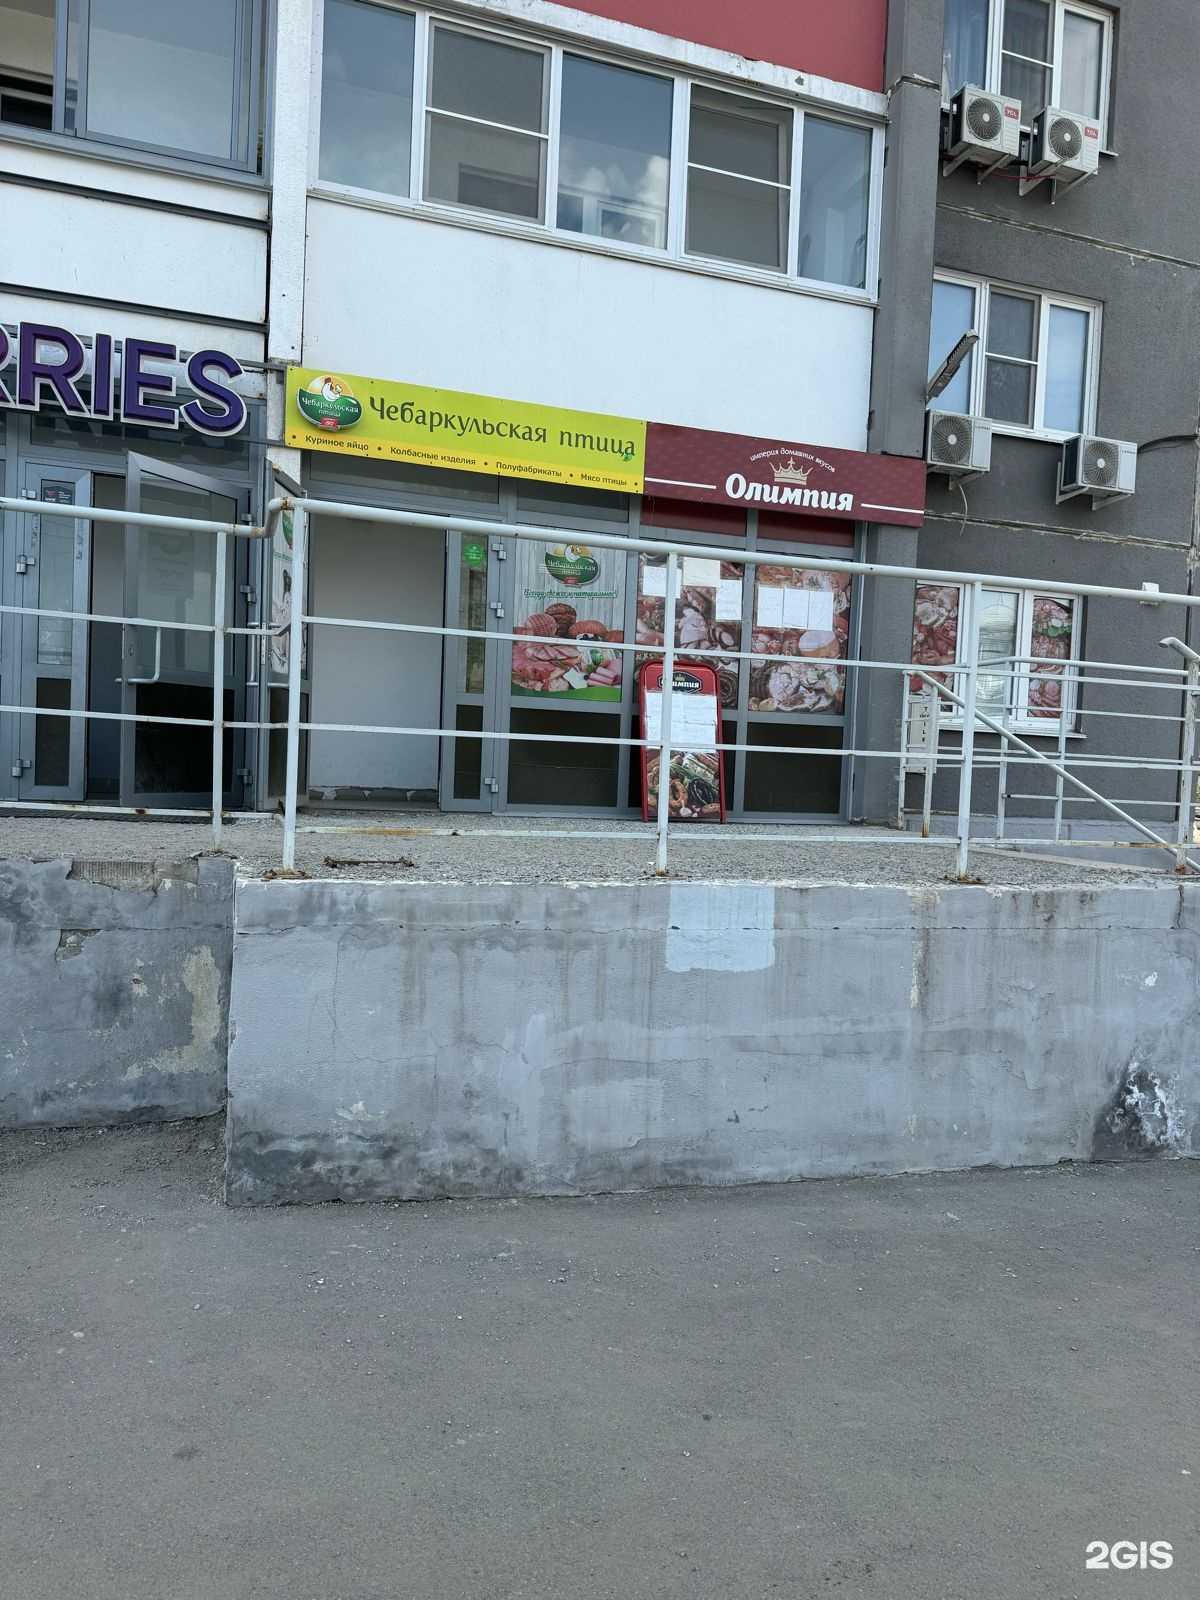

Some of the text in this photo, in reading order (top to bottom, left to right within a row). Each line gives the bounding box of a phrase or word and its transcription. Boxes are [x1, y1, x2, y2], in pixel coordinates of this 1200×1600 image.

[0, 321, 247, 437] RIES
[369, 396, 635, 457] Чебаркульская птица
[305, 435, 627, 487] Куриное яйцо Колбасные изделия Полуфабрикаты Мясо птицы
[725, 473, 854, 511] Олимпия
